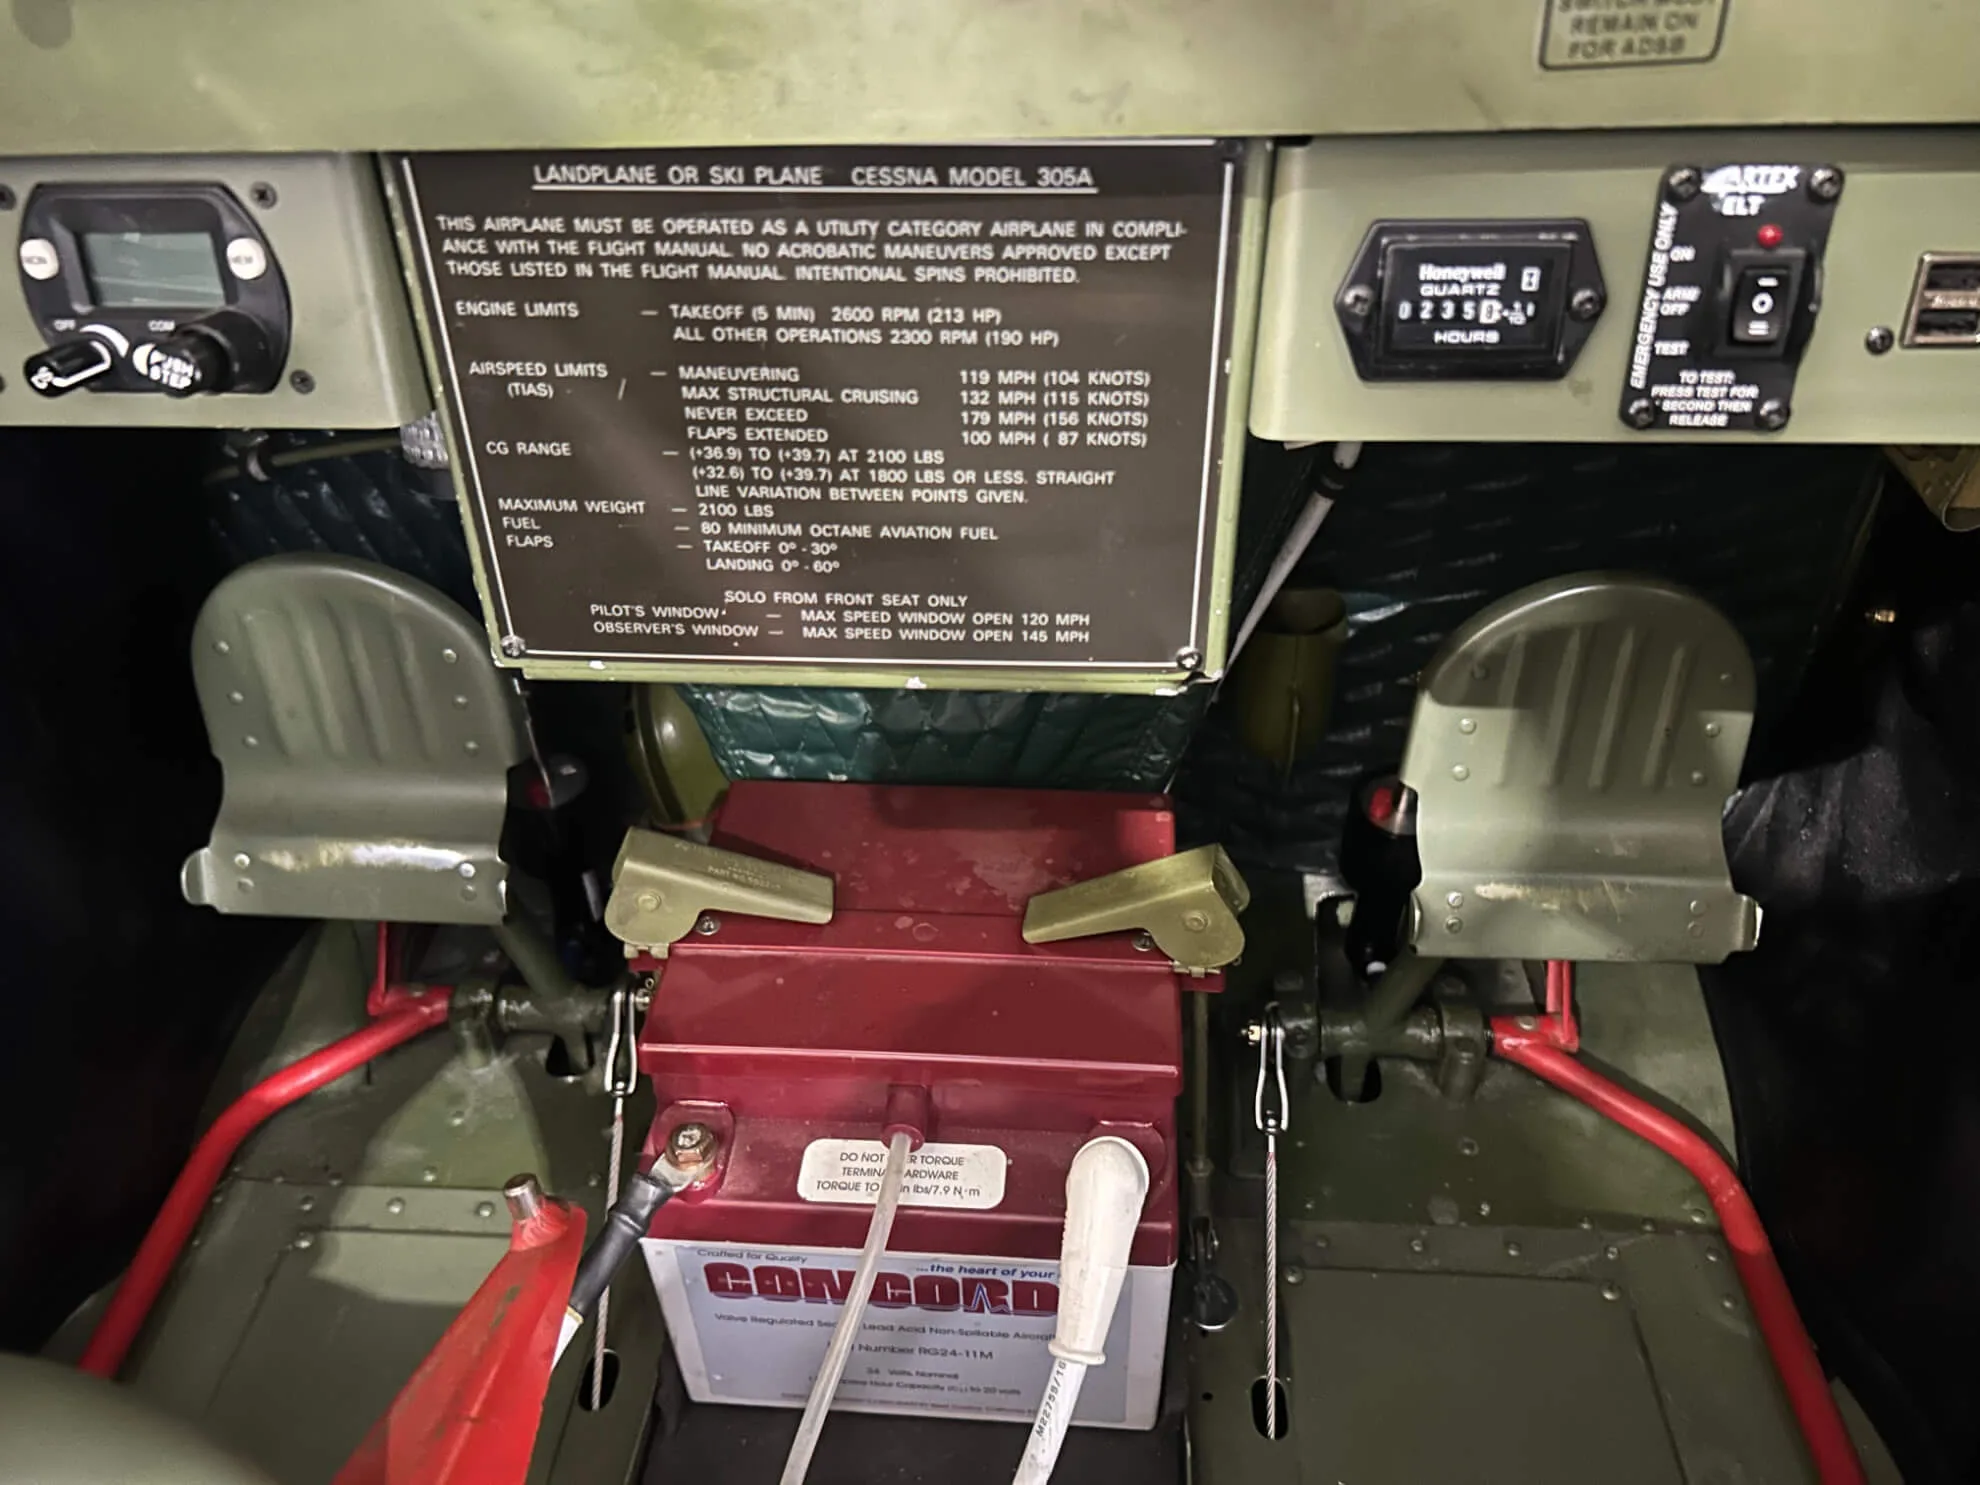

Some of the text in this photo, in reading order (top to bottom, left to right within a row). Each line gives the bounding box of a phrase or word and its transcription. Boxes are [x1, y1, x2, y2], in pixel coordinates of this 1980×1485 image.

[533, 163, 1094, 188] LANDPLANE OR SKI PLANE CESSNA MODEL 305A
[435, 214, 477, 232] THIS
[483, 215, 566, 233] AIRPLANE
[572, 216, 623, 234] MUST
[631, 217, 654, 234] BE
[661, 217, 755, 236] OPERATED
[761, 218, 788, 236] AS
[794, 219, 810, 236] A
[815, 218, 880, 238] UTILITY
[886, 219, 983, 237] CATEGORY
[989, 220, 1077, 238] AIRPLANE
[1084, 220, 1105, 238] IN
[442, 237, 488, 254] ANCE
[494, 239, 540, 255] WITH
[546, 239, 580, 256] THE
[587, 240, 646, 257] FLIGHT
[741, 242, 770, 259] NO
[776, 242, 876, 259] ACROBATIC
[883, 243, 995, 260] MANEUVERS
[1002, 244, 1098, 261] APPROVED
[1104, 243, 1173, 261] EXCEPT
[445, 259, 503, 277] THOSE
[509, 261, 568, 278] LISTED
[574, 262, 594, 278] IN
[599, 262, 634, 279] THE
[640, 263, 699, 280] FLIGHT
[794, 265, 908, 283] INTENTIONAL
[914, 266, 967, 283] SPINS
[974, 266, 1080, 284] PROHIBITED.
[1419, 262, 1507, 283] Honeywell
[1420, 283, 1500, 297] QUARTZ
[1630, 201, 1678, 389] EMERGENCY USE ONLY
[455, 299, 1002, 326] ENGINE LIMITS TAKEOFF (5 MIN) 2600 RPM (213 HP)
[672, 325, 883, 345] ALL OTHER OPERATIONS
[1434, 330, 1500, 343] HOURS
[1655, 341, 1689, 356] TEST
[468, 360, 1151, 388] AIRSPEED LIMITS MANEUVERING 119 MPH (104 KNOTS)
[507, 381, 920, 405] (TIAS) MAX STRUCTURAL CRUISING
[1651, 385, 1694, 397] PRESS
[1696, 386, 1728, 398] TEST
[683, 405, 809, 423] NEVER EXCEED
[1662, 400, 1715, 412] SECOND
[1718, 400, 1752, 412] THEN
[1669, 414, 1728, 426] RELEASE
[686, 425, 829, 443] FLAPS EXTENDED
[485, 440, 945, 465] CG RANGE (+36.9) TO (+39.7) AT 2100 LBS
[695, 484, 730, 498] LINE
[736, 485, 822, 501] VARIATION
[828, 486, 904, 502] BETWEEN
[910, 488, 969, 504] POINTS
[497, 497, 774, 518] MAXIMUM WEIGHT 2100 LBS
[501, 515, 999, 541] FUEL 80 MINIMUM OCTANE AVIATION FUEL
[723, 589, 969, 608] SOLO FROM FRONT SEAT ONLY
[840, 1152, 858, 1162] DO
[860, 1153, 883, 1163] NOT
[920, 1156, 965, 1167] TORQUE
[904, 1169, 959, 1180] ARDWARE
[817, 1180, 861, 1192] TORQUE
[865, 1181, 880, 1192] TO
[958, 1265, 996, 1275] heart
[1001, 1268, 1016, 1276] of
[1020, 1270, 1055, 1279] your
[704, 1261, 1060, 1317] CONCORD
